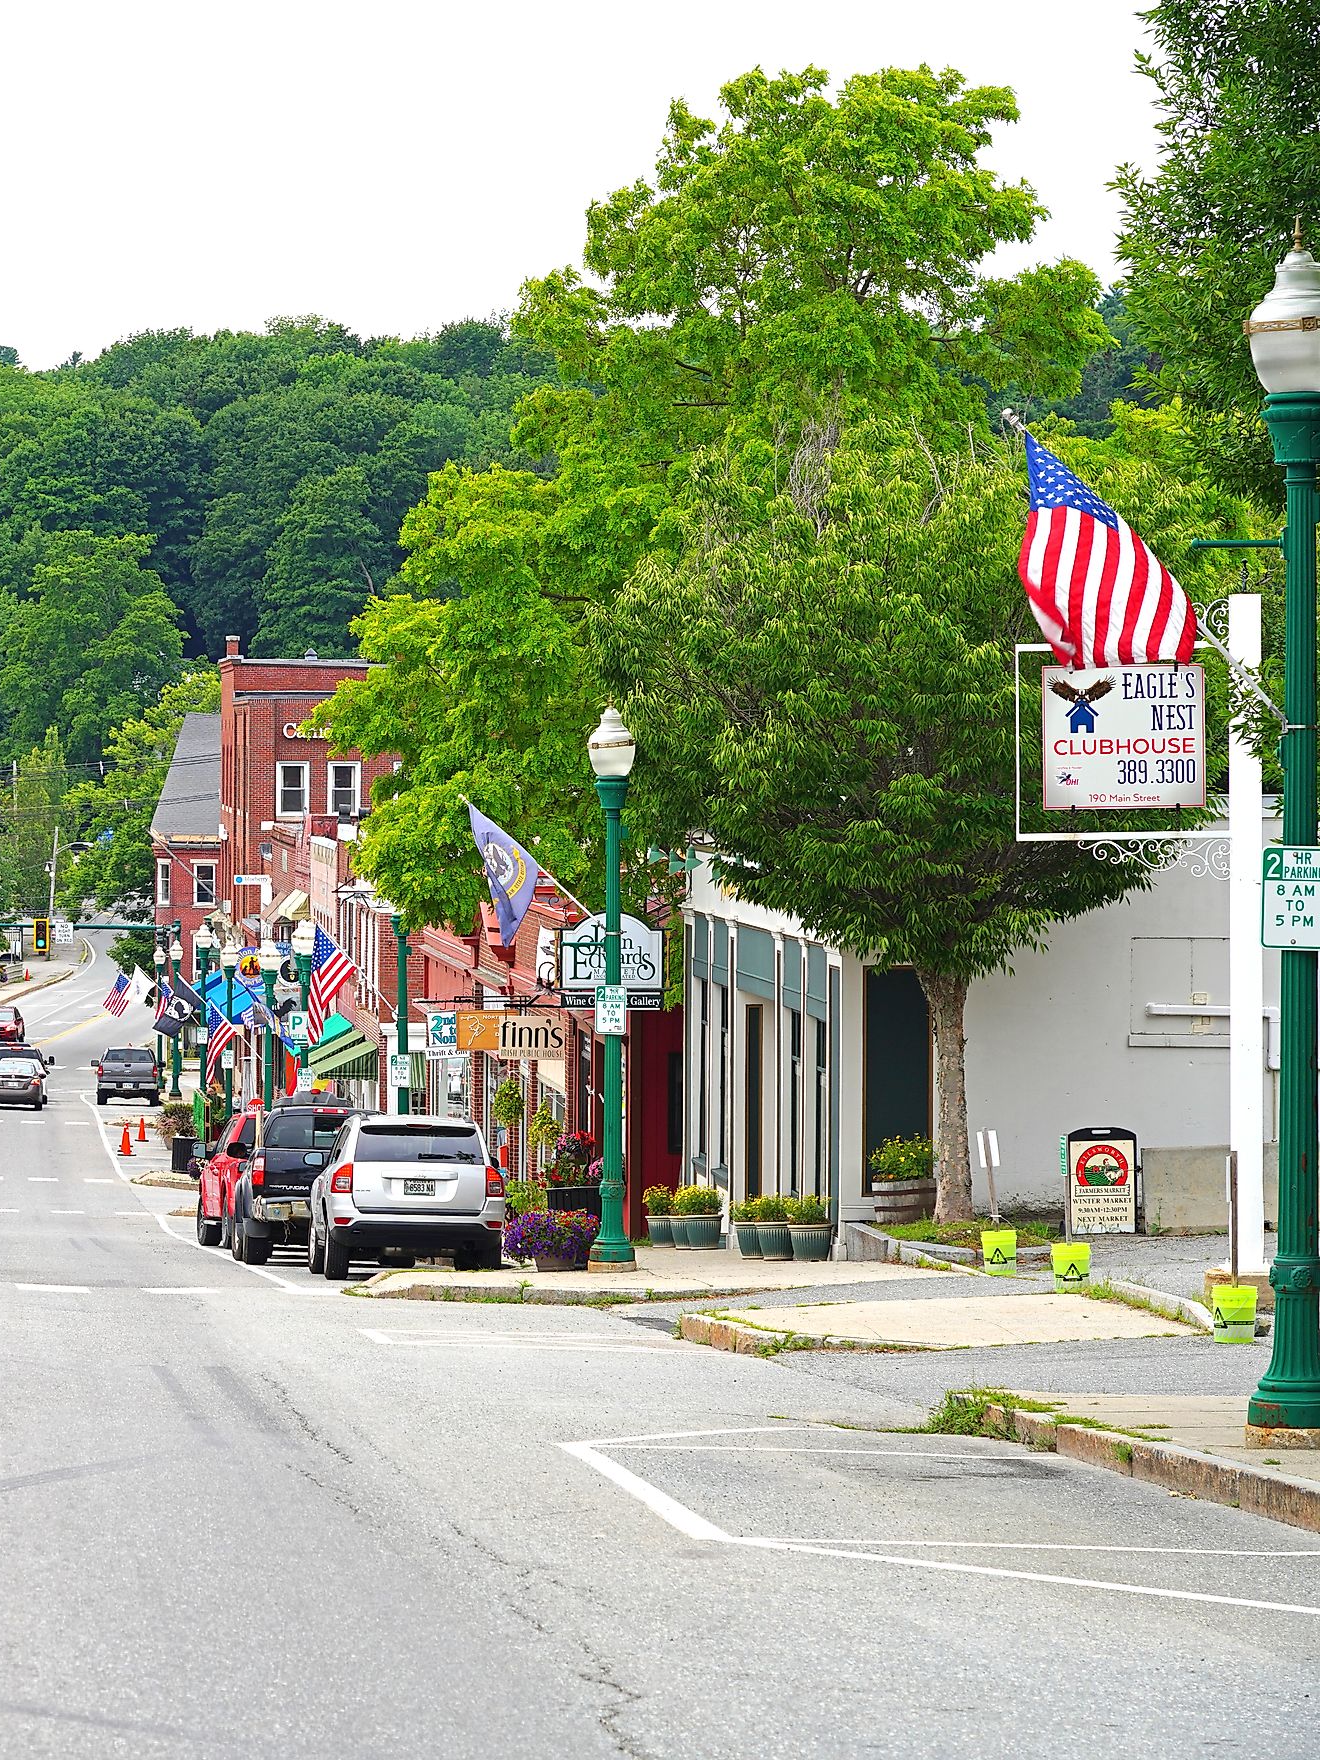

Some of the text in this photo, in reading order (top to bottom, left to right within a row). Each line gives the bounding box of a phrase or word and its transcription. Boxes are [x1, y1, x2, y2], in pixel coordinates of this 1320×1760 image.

[1122, 672, 1195, 700] EAGLE'S
[1151, 705, 1196, 731] NEST
[1053, 737, 1196, 755] CLUBHOUSE
[1117, 758, 1196, 785] 389.3300
[1088, 793, 1161, 803] 190 Main Street
[1266, 852, 1312, 878] 2 HR
[1284, 866, 1320, 879] PARKIN
[1276, 884, 1315, 897] 8 AM
[1285, 899, 1305, 911] TO
[1275, 914, 1314, 928] 5 PM
[577, 924, 635, 956] Jn
[565, 996, 587, 1006] Wine
[630, 996, 661, 1007] Gallery
[597, 988, 605, 1001] 2
[291, 1015, 303, 1031] P
[501, 1018, 564, 1049] finn's
[391, 1056, 397, 1065] 2
[500, 1049, 563, 1058] IRISH PUBLIC HOUSE
[1080, 1147, 1124, 1165] ELLSWORTH
